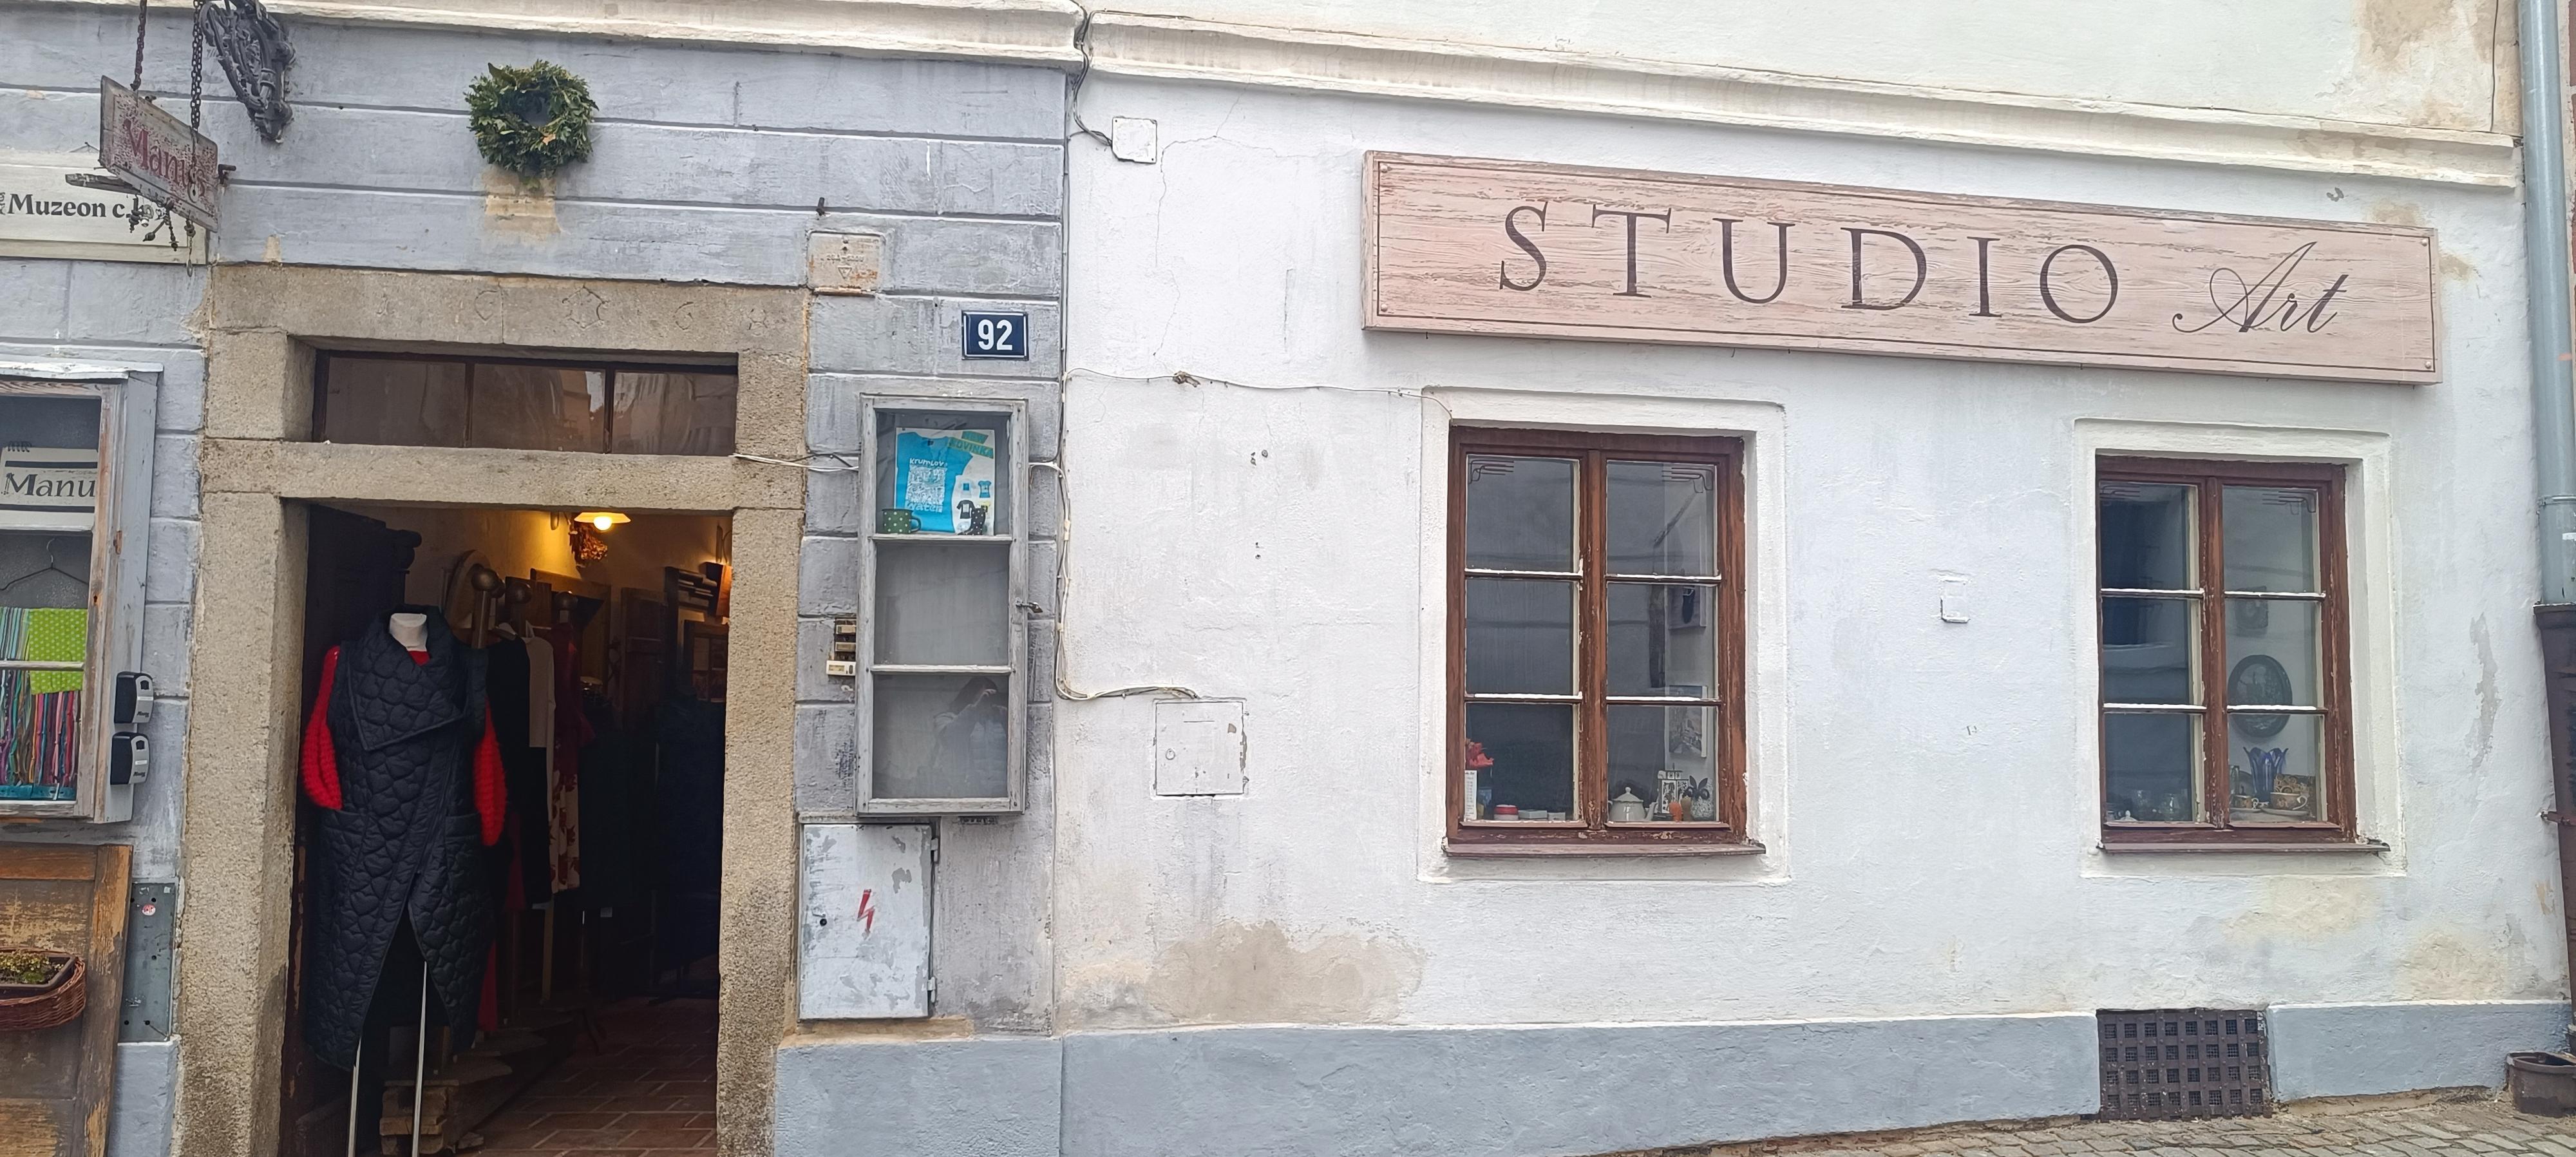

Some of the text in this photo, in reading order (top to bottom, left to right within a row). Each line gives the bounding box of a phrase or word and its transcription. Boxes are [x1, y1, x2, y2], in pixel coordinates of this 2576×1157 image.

[6, 193, 107, 218] Muzeon
[1499, 200, 2349, 333] STUDIO Art
[978, 319, 1013, 350] 92
[3, 472, 95, 497] Manu
